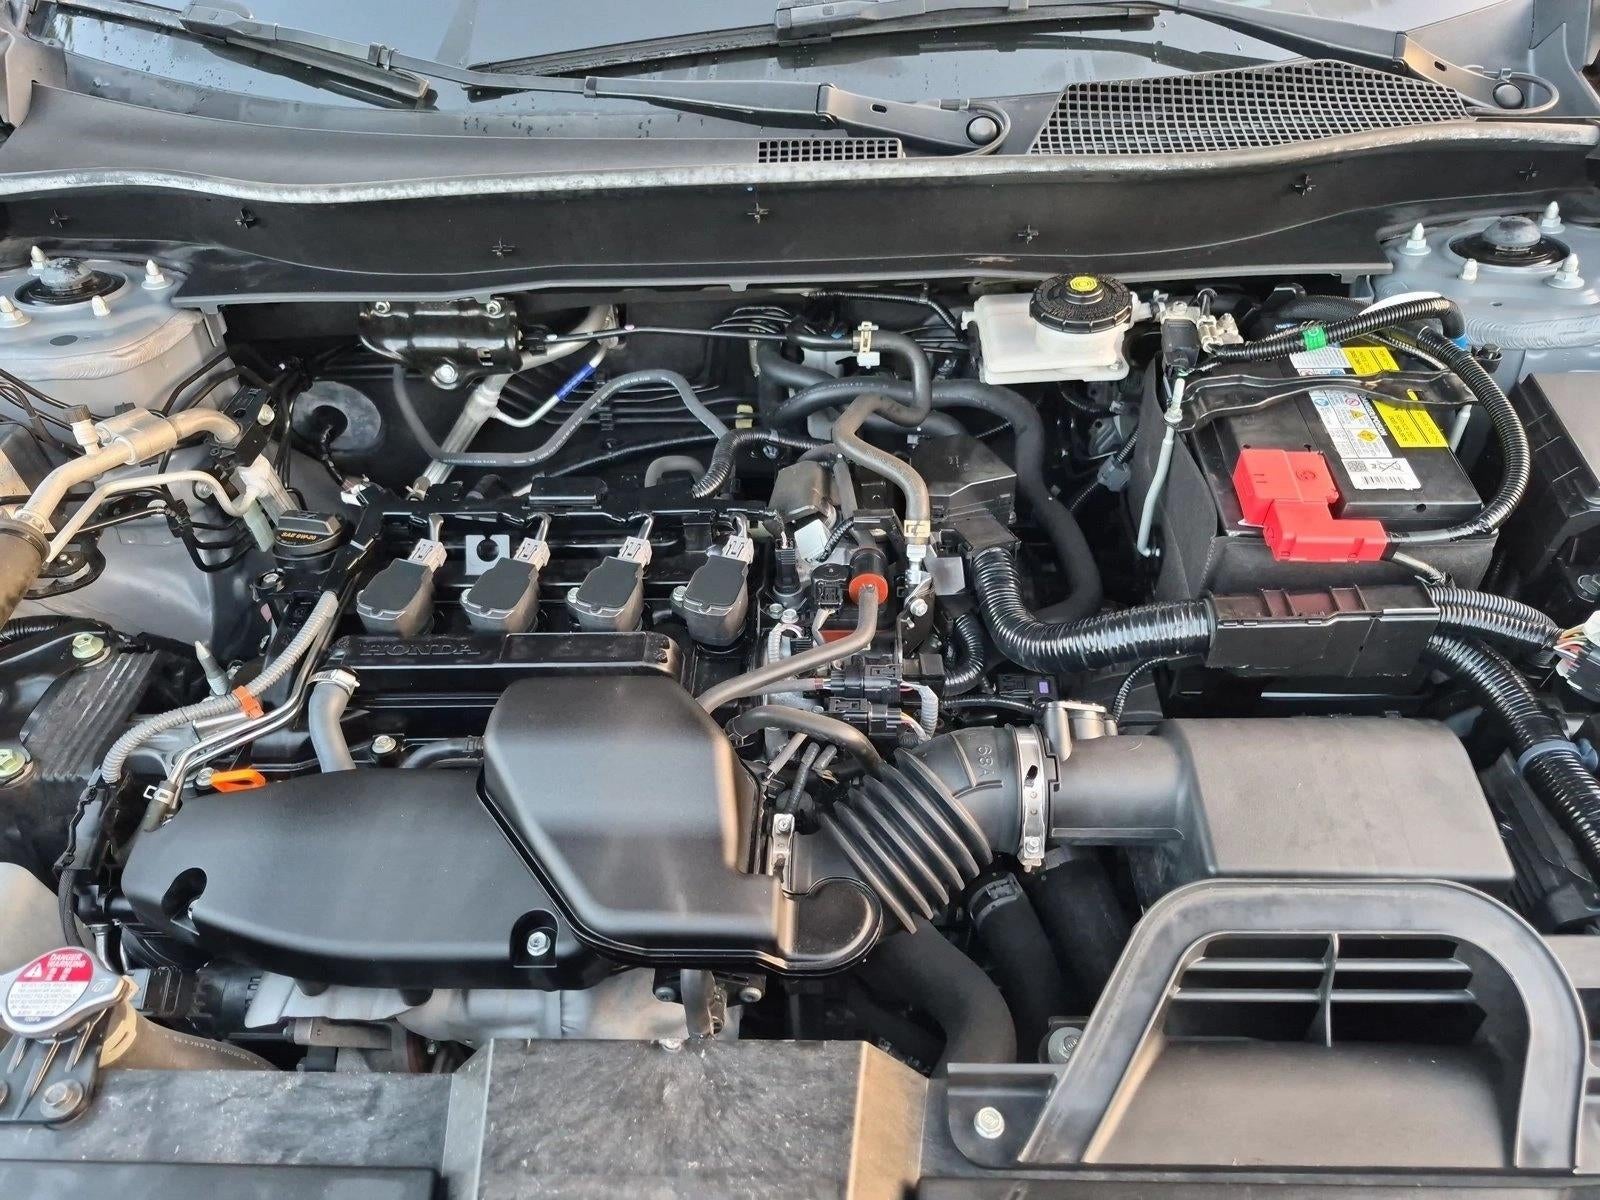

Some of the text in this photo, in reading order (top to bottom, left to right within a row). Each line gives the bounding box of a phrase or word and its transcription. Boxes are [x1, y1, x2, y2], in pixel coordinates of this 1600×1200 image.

[359, 643, 481, 656] HONDA
[50, 953, 83, 961] DANGER
[47, 960, 87, 968] WARNING
